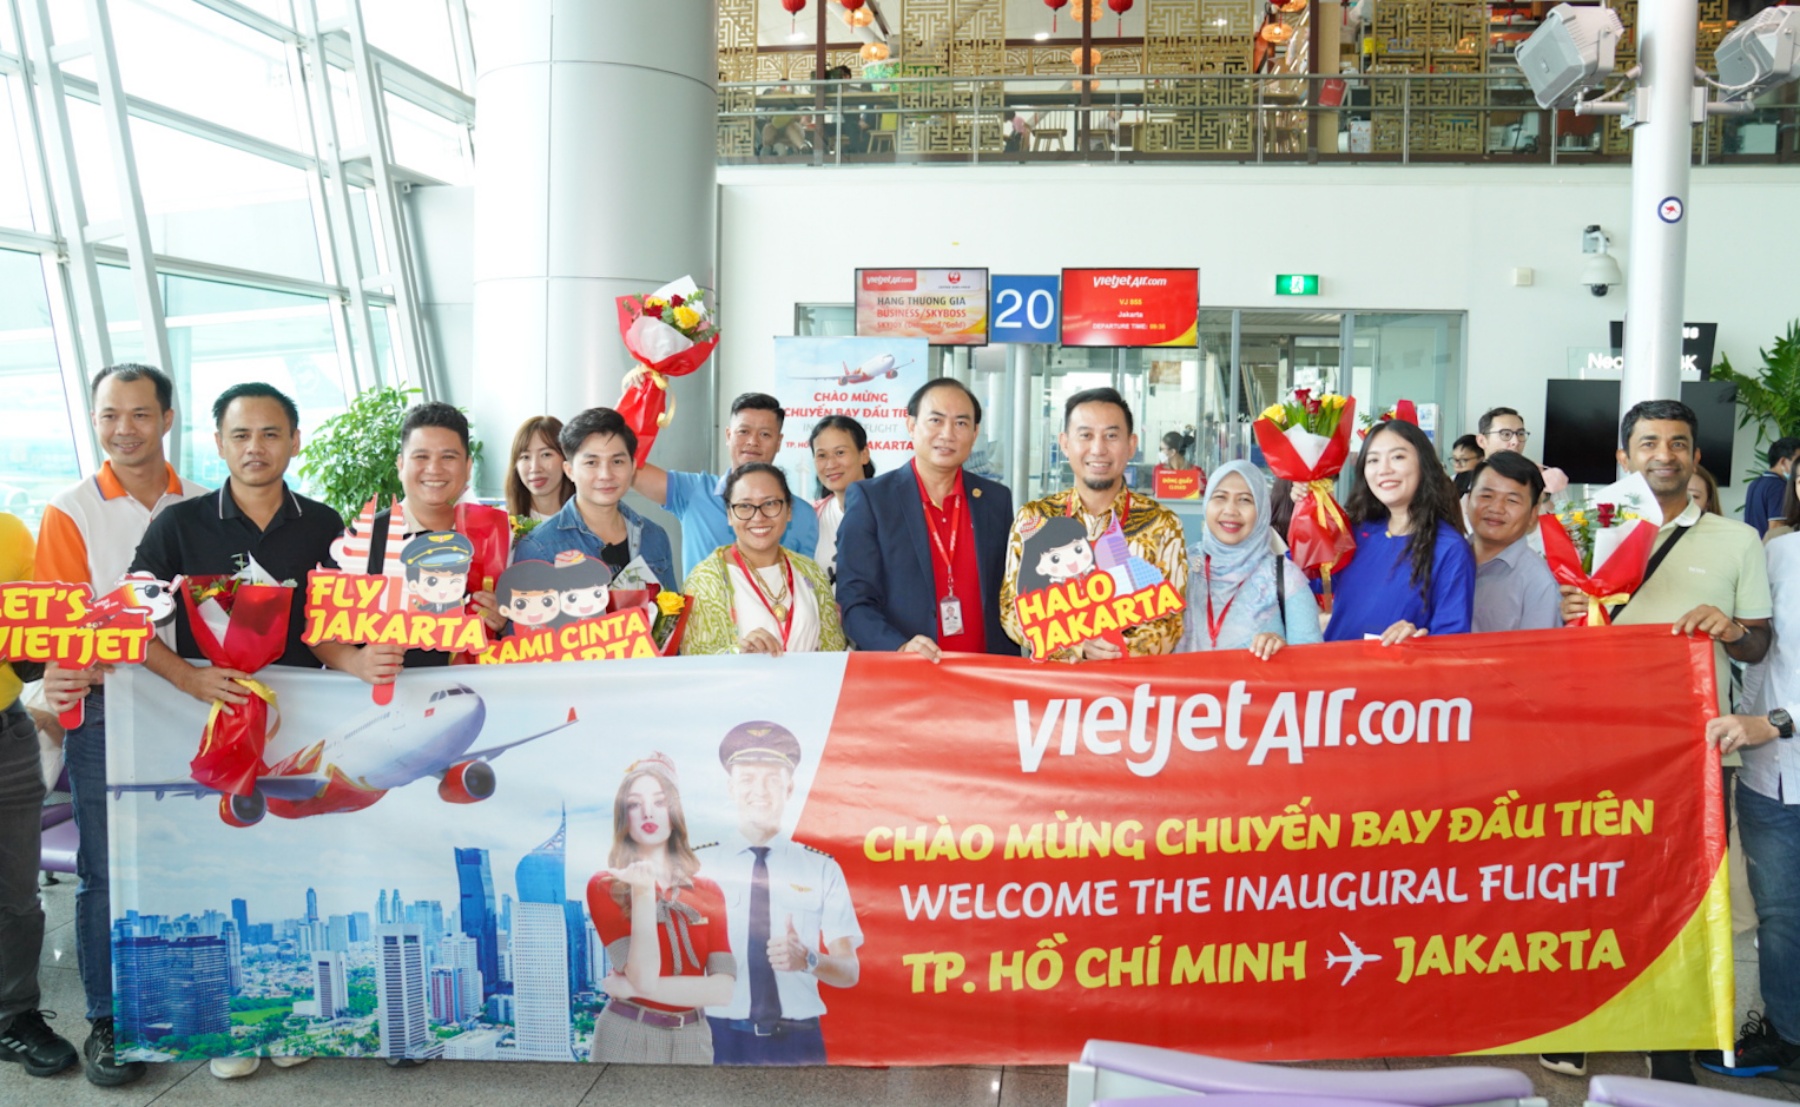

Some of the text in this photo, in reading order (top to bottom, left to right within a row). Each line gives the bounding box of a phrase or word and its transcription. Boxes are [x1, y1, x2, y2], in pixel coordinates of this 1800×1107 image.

[949, 296, 967, 306] GIA
[994, 288, 1055, 330] 20
[1117, 310, 1144, 319] Jakarta
[1092, 323, 1130, 331] DEPARTURE
[813, 389, 849, 402] CHÀO
[867, 440, 915, 451] AKARTA
[0, 587, 87, 622] ET'S
[311, 575, 385, 609] FLY
[1017, 573, 1113, 626] HALO
[307, 609, 486, 650] JAKARTA
[478, 612, 647, 665] KAMI CINTA
[1025, 583, 1183, 659] JAKARTA
[863, 790, 1655, 862] CHÀO MỪNG CHUYẾN BAY ĐẦU TIÊN
[899, 860, 1625, 921] WELCOME THE INAUGURAL FLIGHT
[902, 928, 1626, 994] TP. HỒ CHÍ MINH JAKARTA
